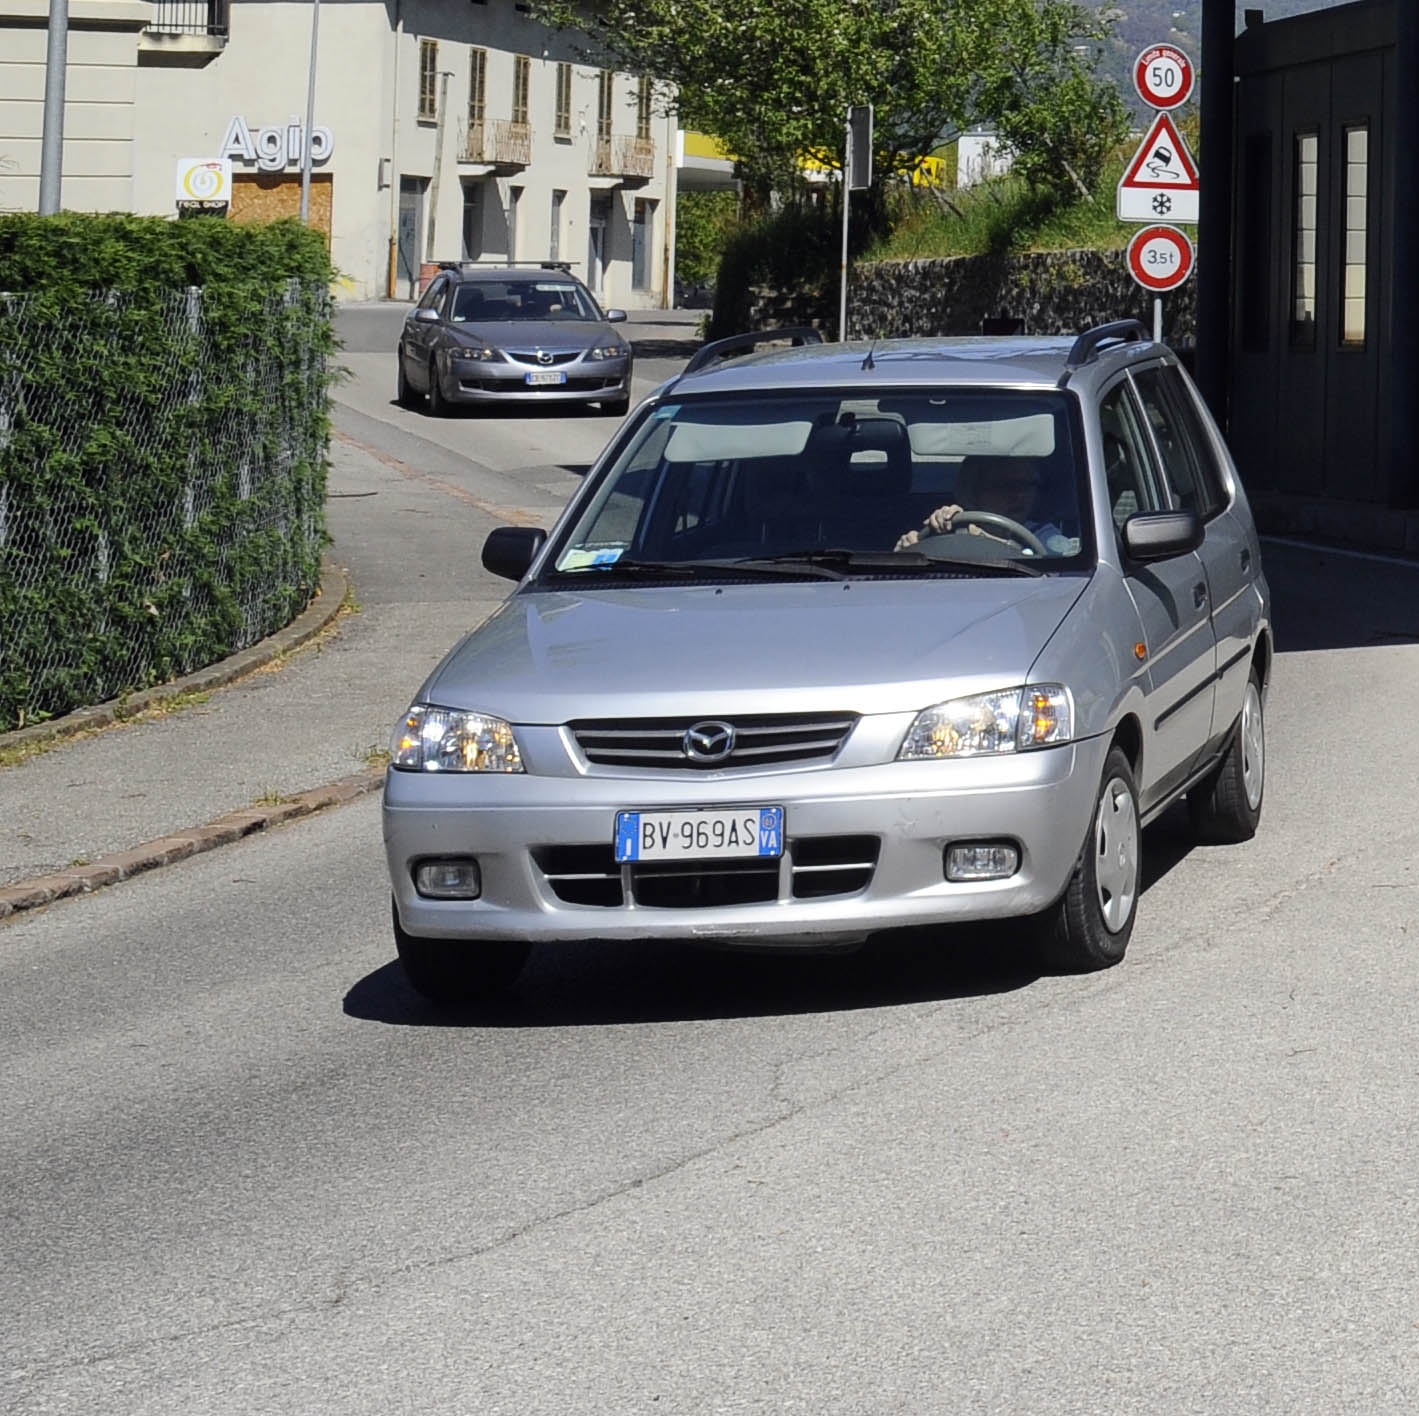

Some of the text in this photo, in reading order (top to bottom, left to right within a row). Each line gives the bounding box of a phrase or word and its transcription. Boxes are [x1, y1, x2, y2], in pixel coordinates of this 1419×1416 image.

[1152, 67, 1175, 88] 50
[219, 115, 335, 172] Agip
[760, 830, 778, 849] VA
